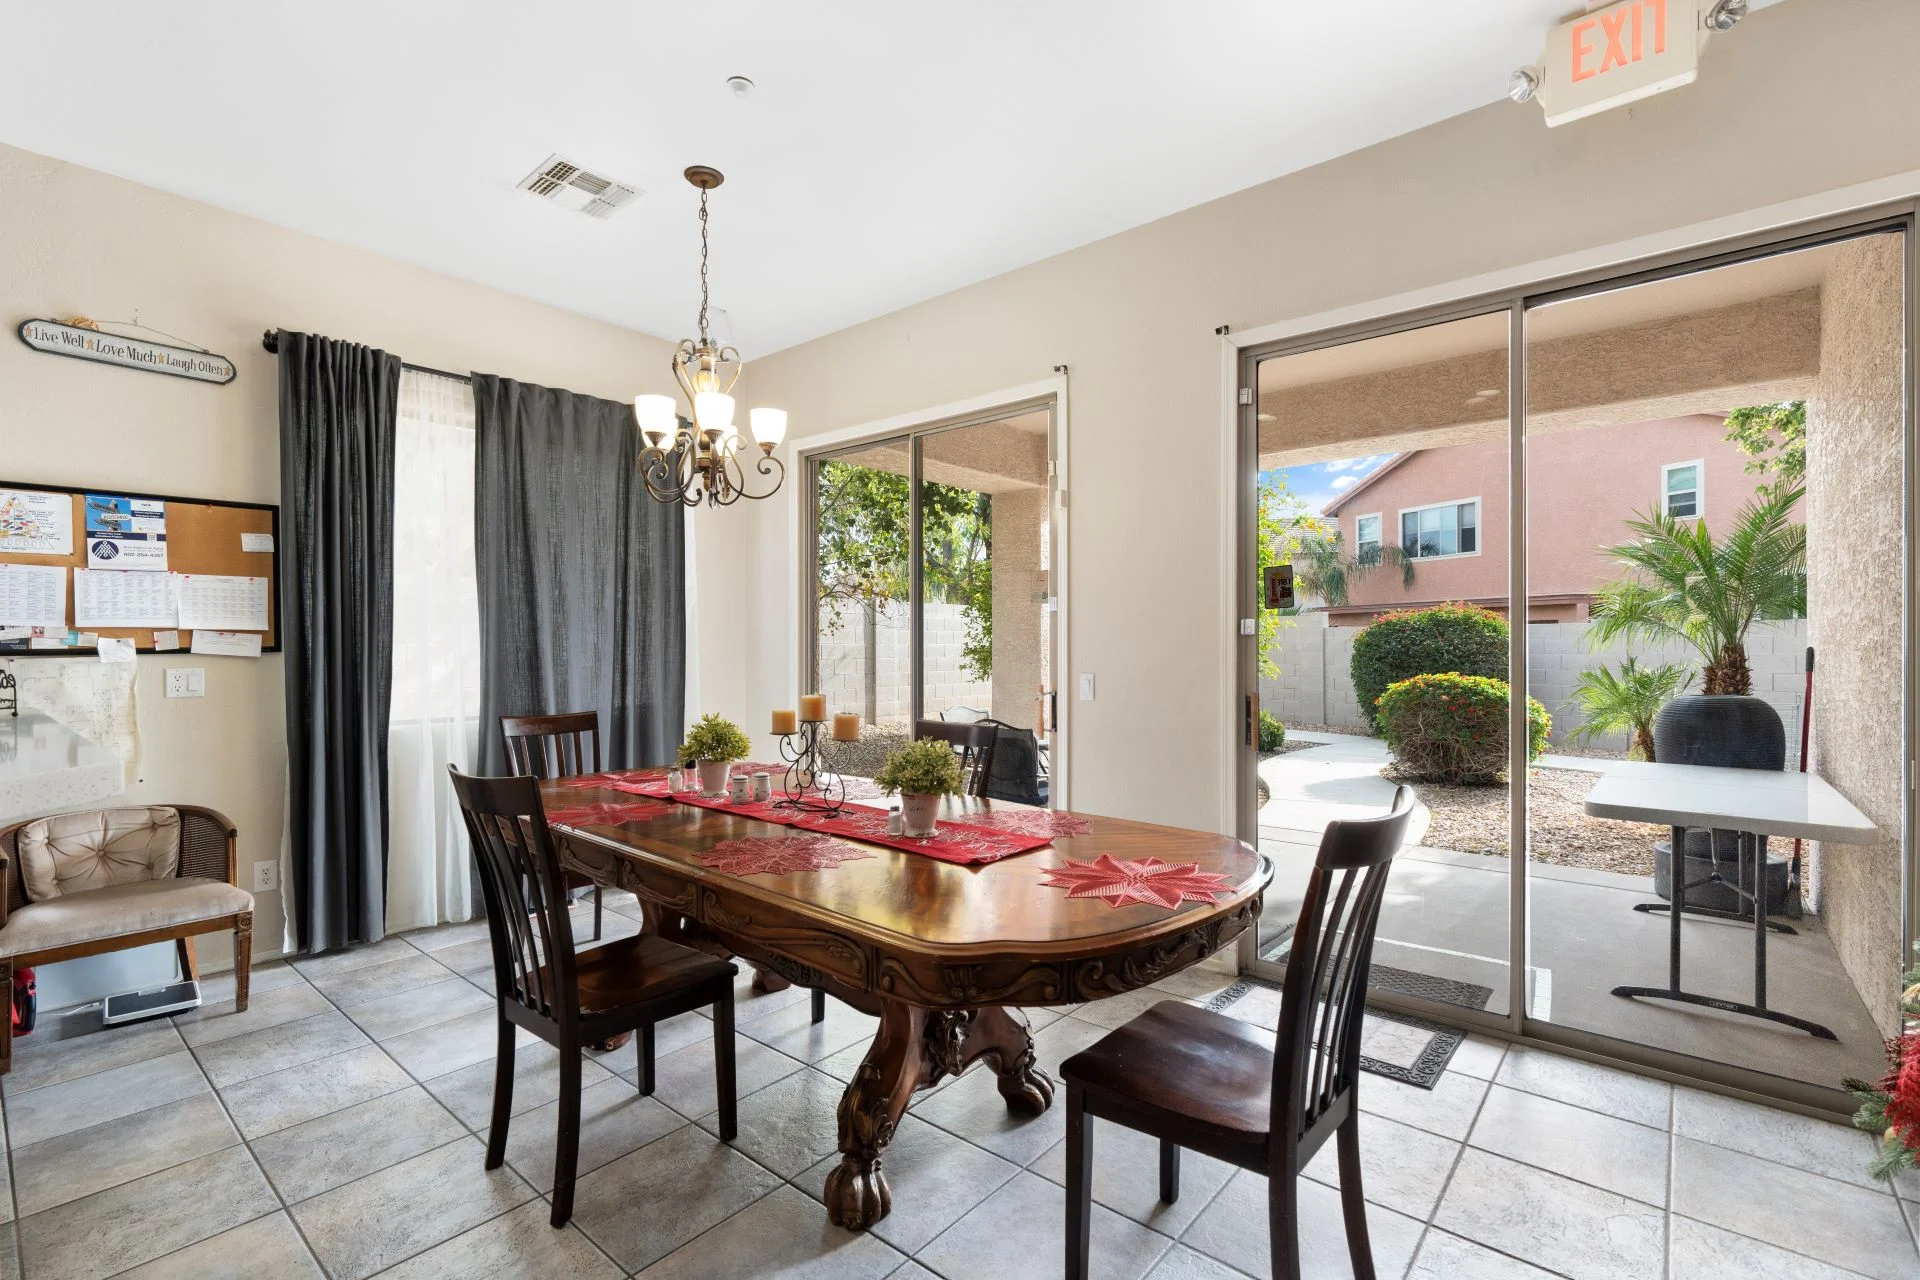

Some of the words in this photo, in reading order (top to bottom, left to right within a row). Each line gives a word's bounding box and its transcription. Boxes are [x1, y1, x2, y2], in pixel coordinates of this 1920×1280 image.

[1571, 0, 1667, 83] EXIT
[34, 327, 58, 344] Live
[61, 331, 84, 348] Well
[96, 339, 124, 358] Love
[126, 345, 156, 365] Much
[166, 353, 197, 372] Laugh
[198, 360, 223, 376] Often
